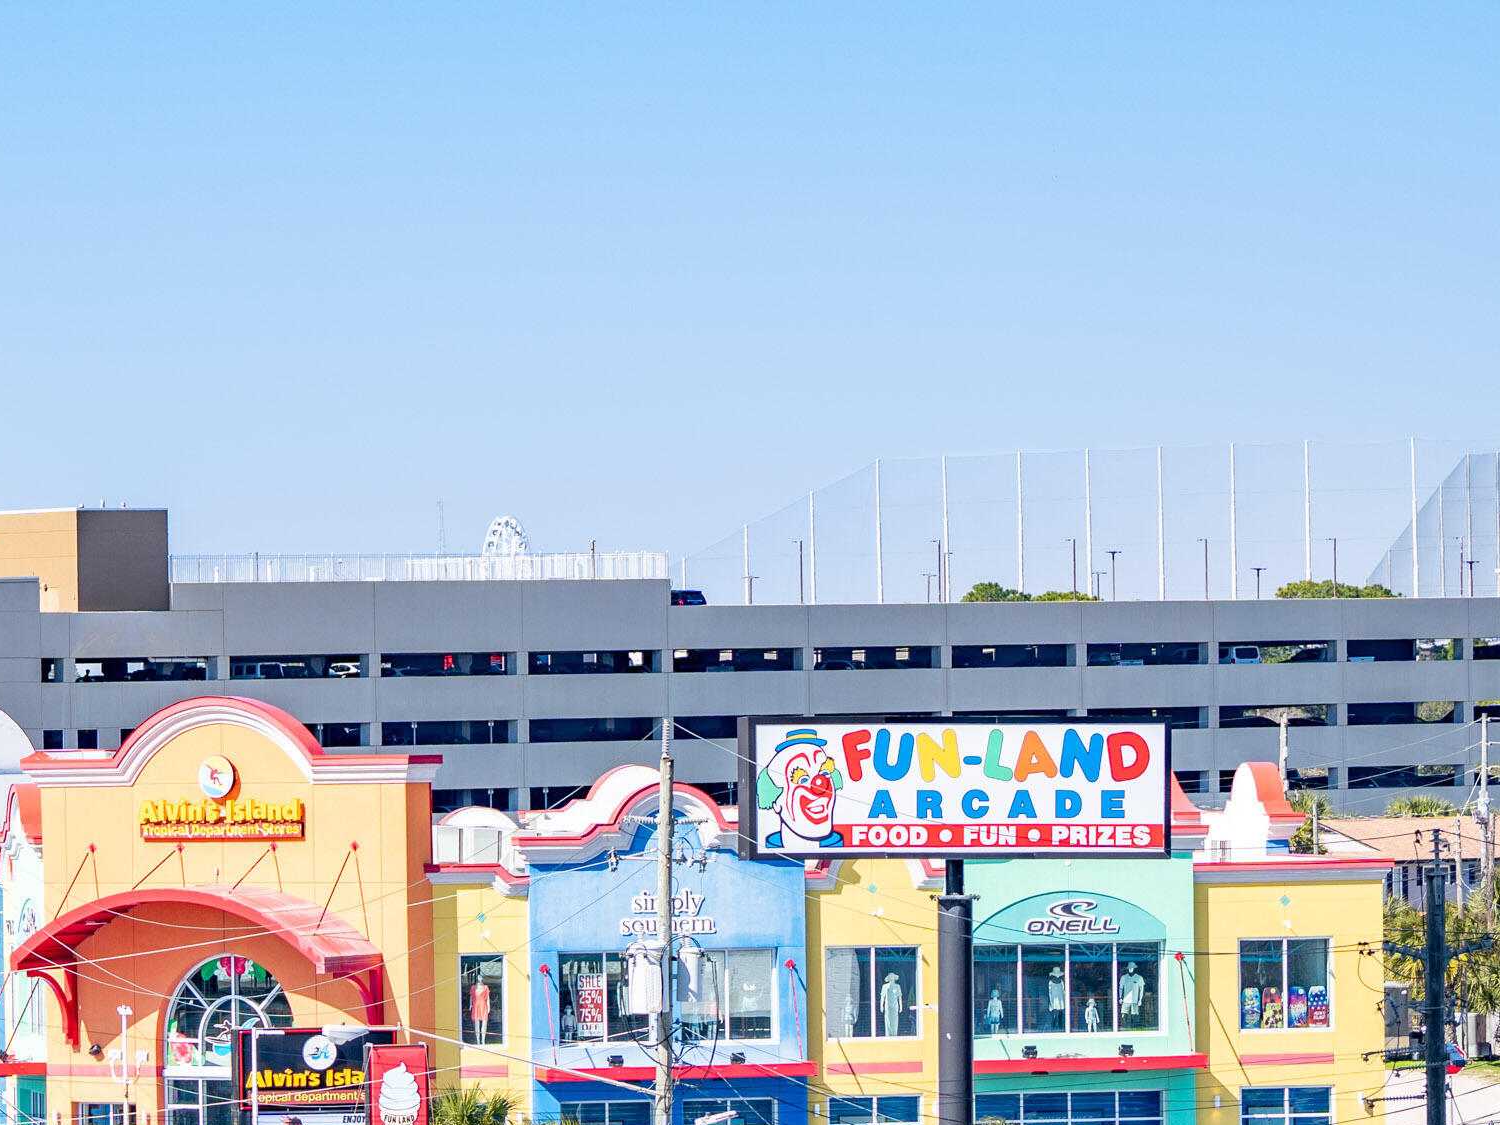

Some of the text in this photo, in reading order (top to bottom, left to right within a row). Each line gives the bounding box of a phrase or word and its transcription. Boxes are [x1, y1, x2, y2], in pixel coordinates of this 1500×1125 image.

[842, 728, 1150, 782] FUN-LAND
[137, 799, 301, 823] Alvin's Island
[868, 789, 1126, 819] ARCADE
[142, 823, 300, 838] Tropical Department Stores
[852, 825, 1151, 846] FOOD FUN PRIZES
[1027, 919, 1118, 933] O'NEILL
[579, 975, 602, 988] SALE
[579, 991, 602, 1004] 25%
[580, 1009, 602, 1022] 75%
[246, 1068, 320, 1088] Alvin's
[294, 1091, 356, 1104] department
[342, 1115, 366, 1124] ENJOY
[384, 1115, 415, 1124] FUN LAND
